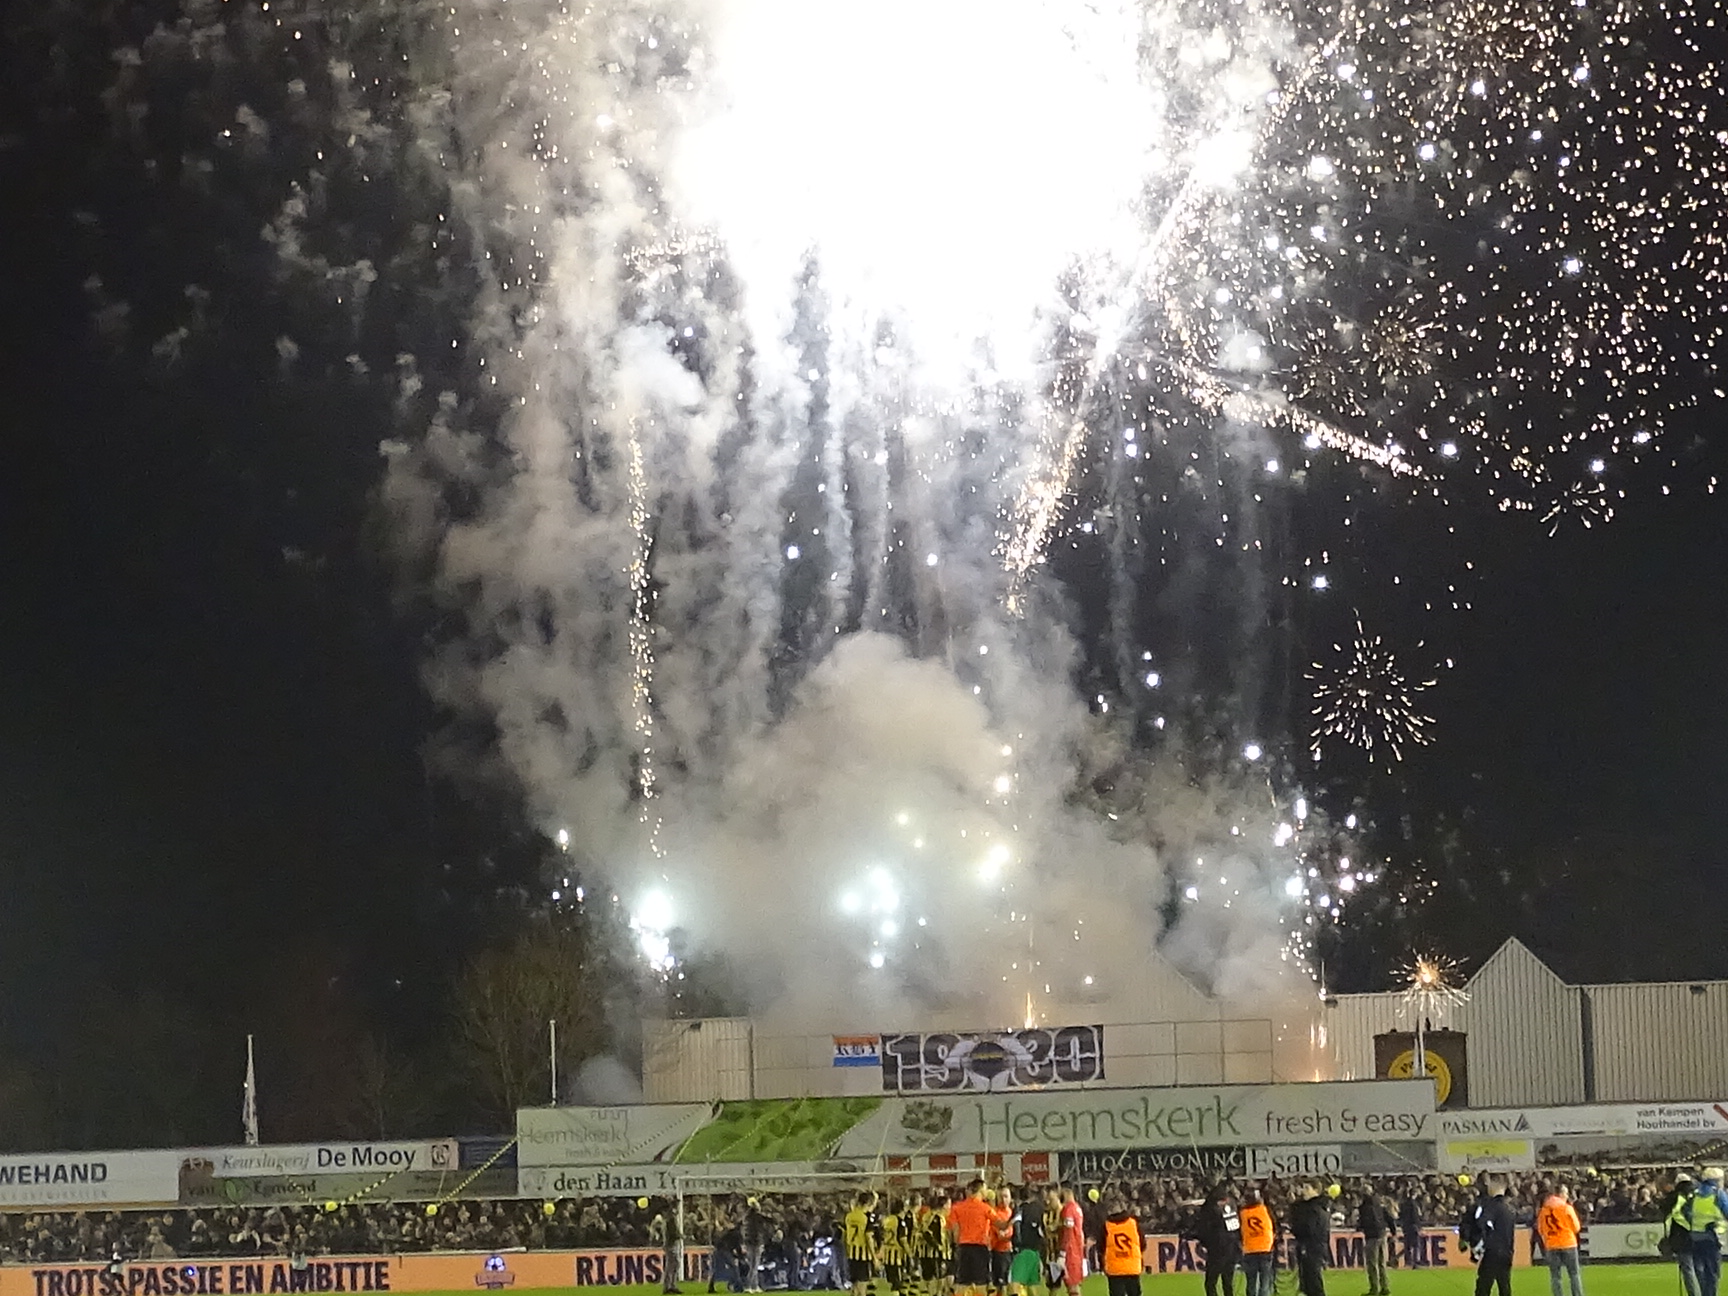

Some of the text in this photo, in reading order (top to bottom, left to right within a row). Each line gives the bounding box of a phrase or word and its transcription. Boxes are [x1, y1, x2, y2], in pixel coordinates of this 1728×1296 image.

[975, 1094, 1241, 1143] Heemskerk
[1265, 1108, 1331, 1135] fresh
[1364, 1112, 1428, 1137] easy
[1636, 1107, 1705, 1119] van Kempen
[1636, 1118, 1698, 1130] Houthandel
[1441, 1120, 1512, 1135] PASMAN
[316, 1148, 347, 1168] De
[351, 1145, 418, 1171] Mooy
[1082, 1145, 1341, 1177] HOGEWONING Esatto
[553, 1173, 589, 1191] den
[595, 1172, 647, 1190] Haan
[229, 1263, 264, 1294] EN
